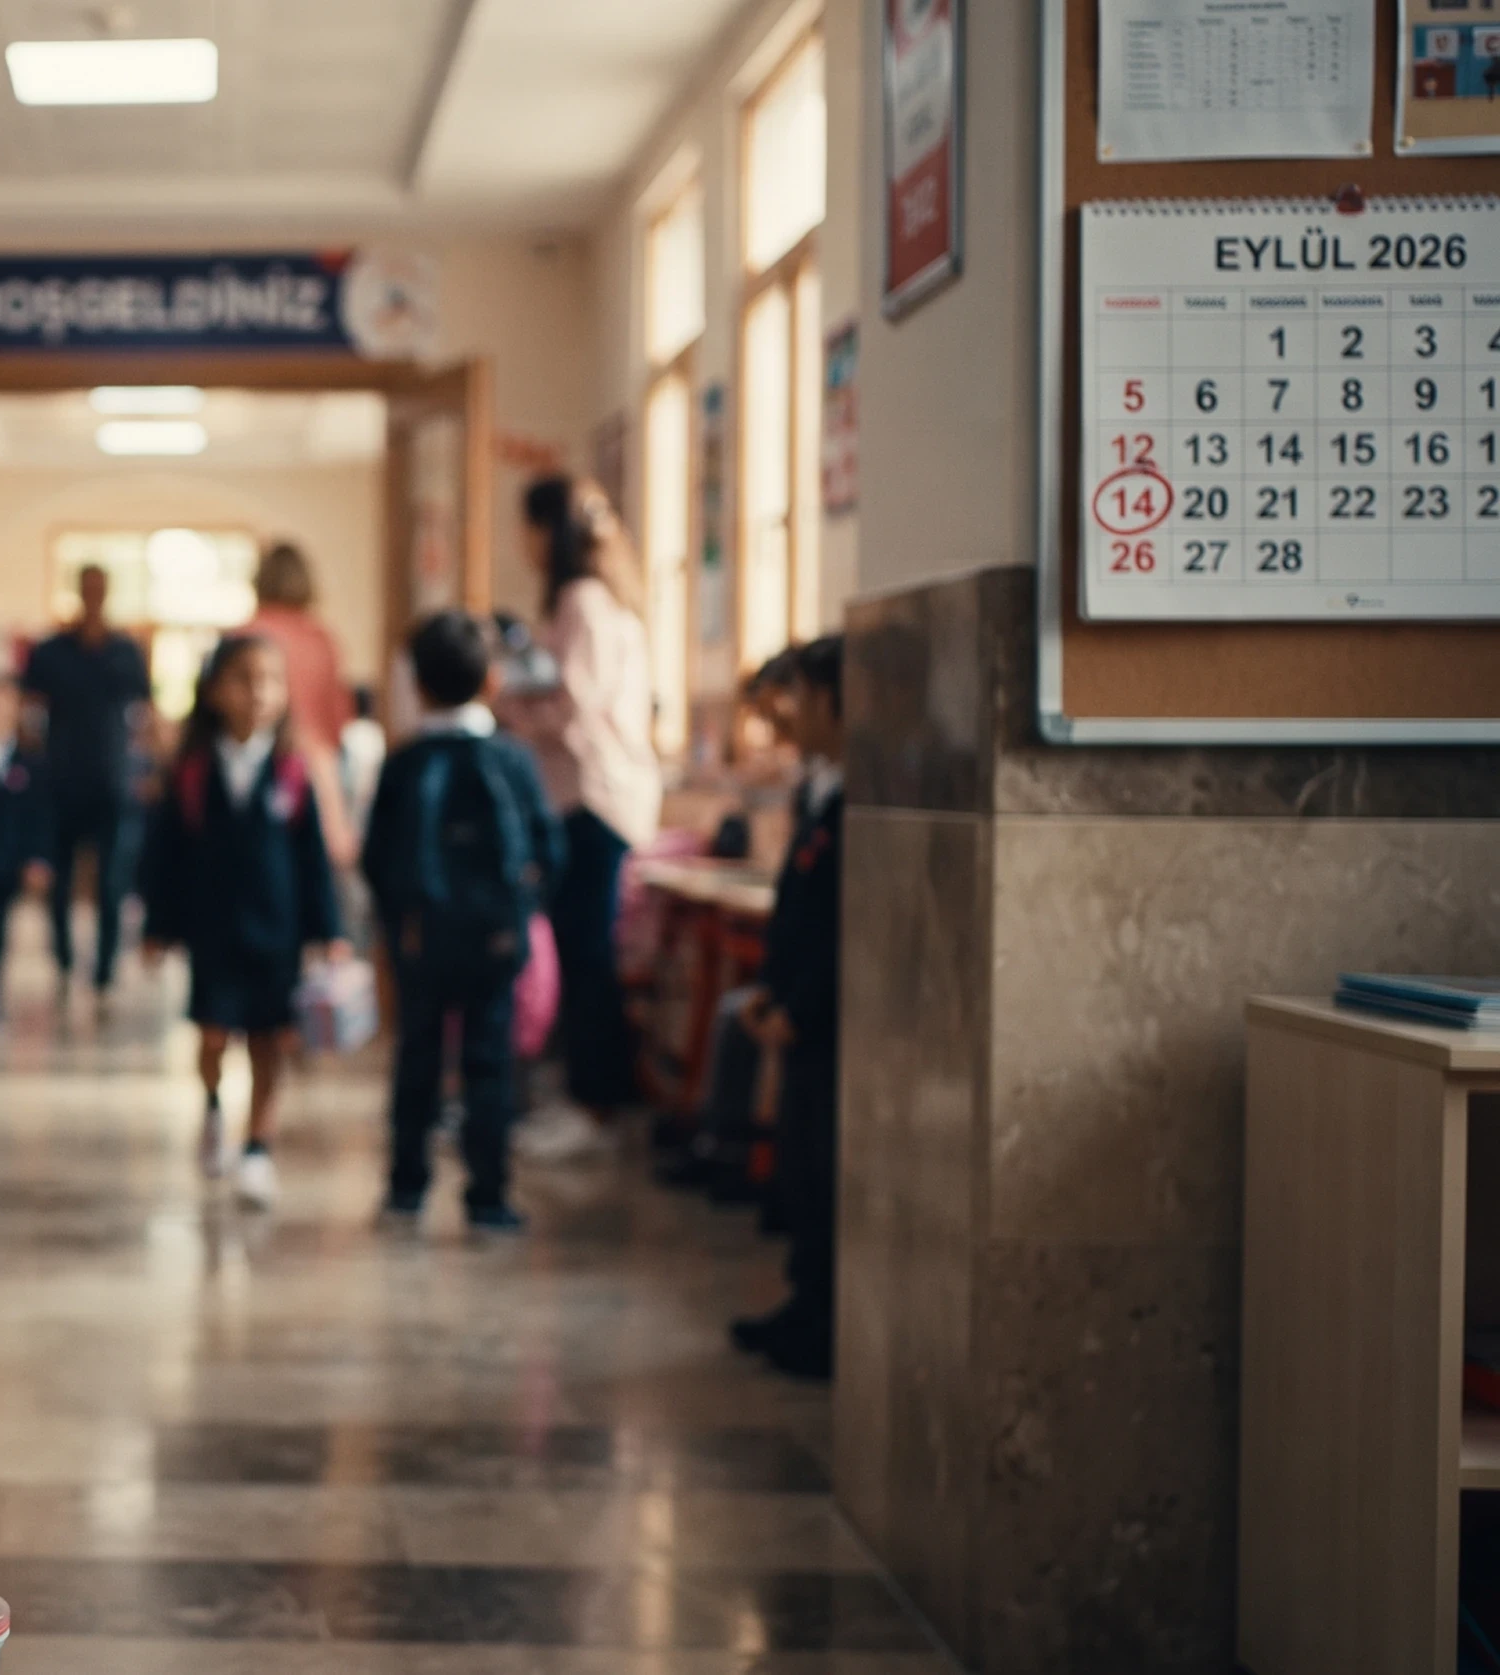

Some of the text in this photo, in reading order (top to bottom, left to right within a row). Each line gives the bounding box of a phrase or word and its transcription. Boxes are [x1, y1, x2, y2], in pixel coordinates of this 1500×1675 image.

[1215, 228, 1468, 271] EYLÜL 2026
[1269, 326, 1285, 359] 1
[1340, 326, 1364, 359] 2
[1415, 325, 1438, 358] 3
[1123, 377, 1495, 413] 5 6 7 8 9 1
[1111, 431, 1496, 467] 12 13 14 15 16 1
[1111, 485, 1500, 520] 14 20 21 22 23 2
[1110, 541, 1303, 573] 26 27 28
